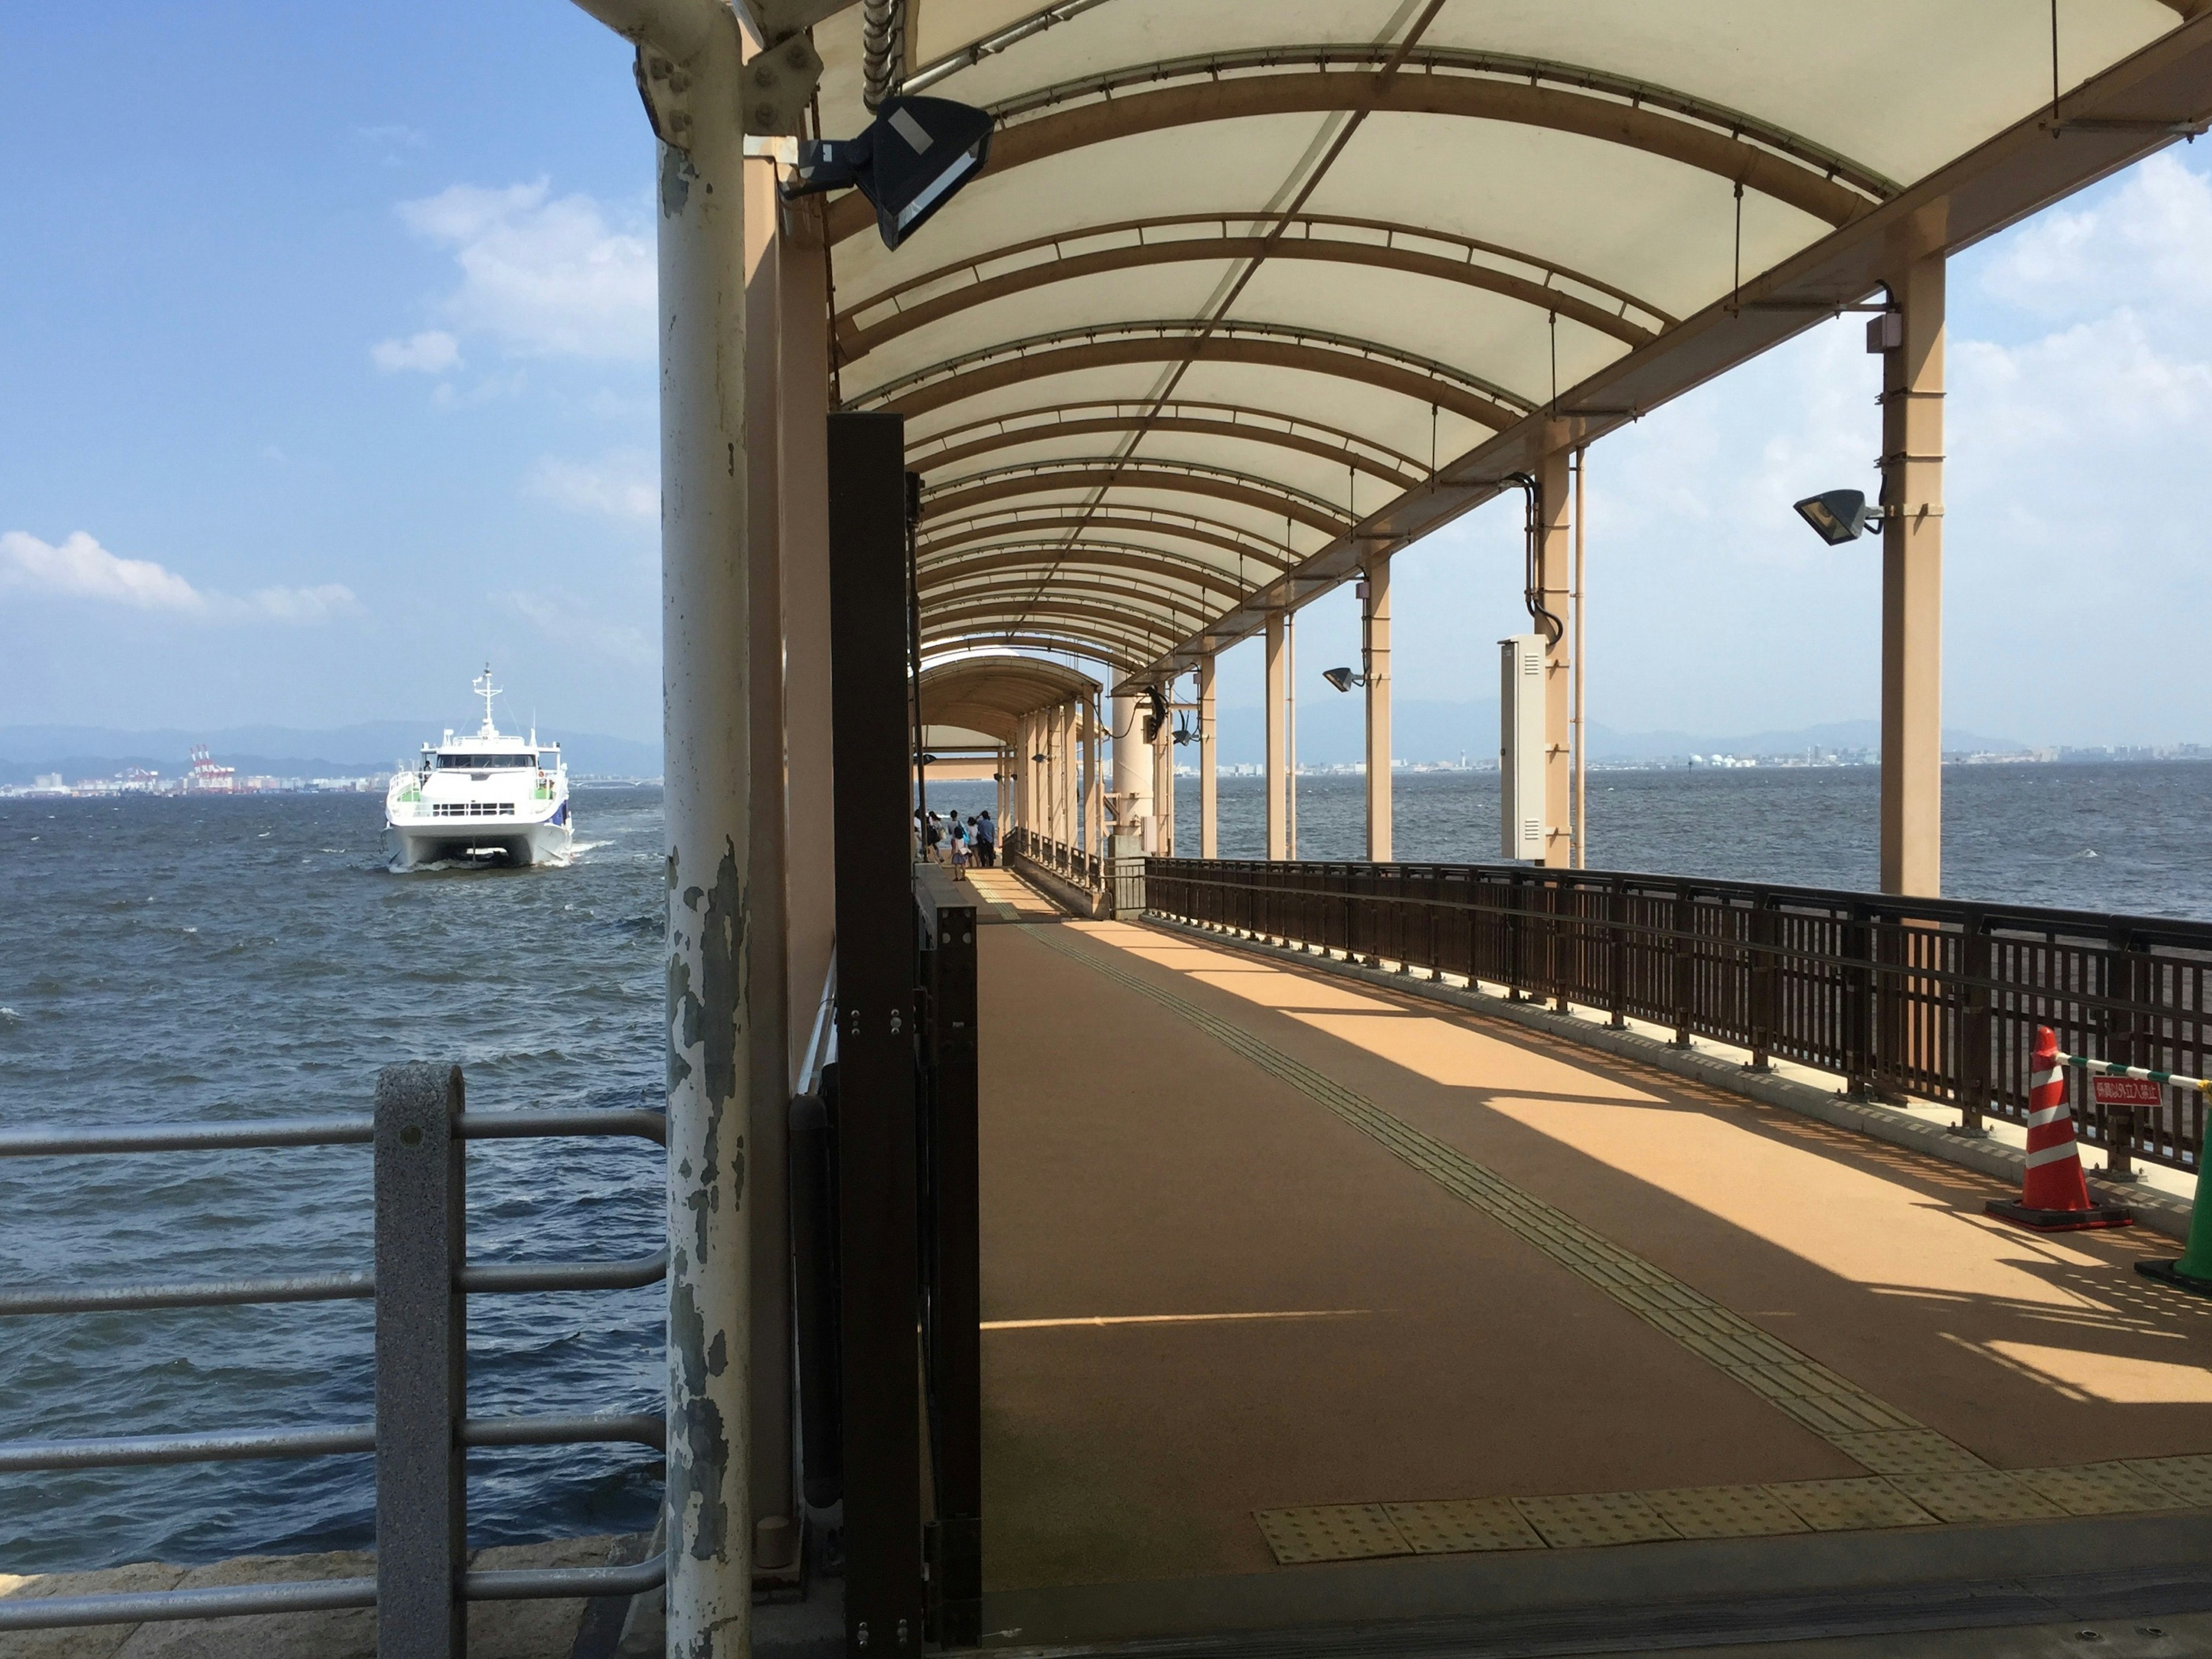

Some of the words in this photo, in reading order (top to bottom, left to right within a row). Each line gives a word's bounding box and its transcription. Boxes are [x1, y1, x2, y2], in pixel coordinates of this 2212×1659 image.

[2097, 1082, 2157, 1100] 係員以外立入禁止
